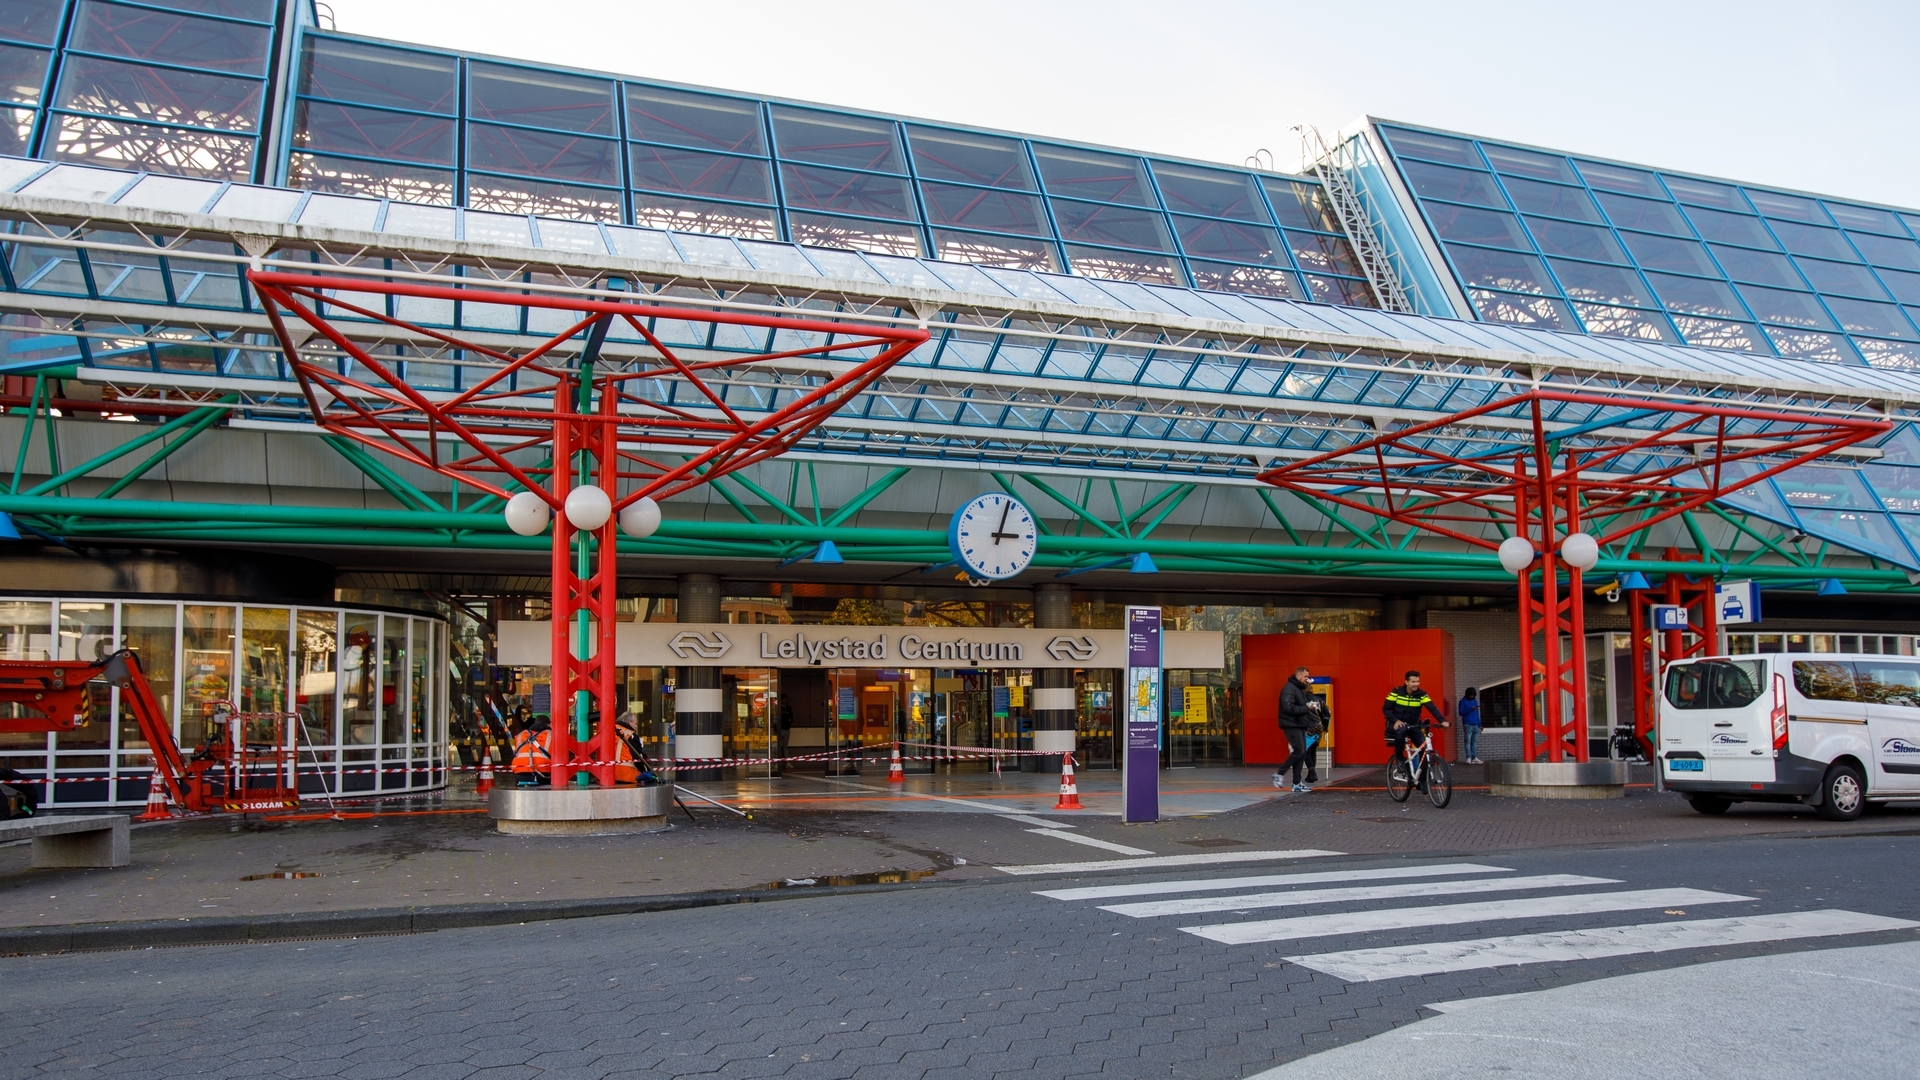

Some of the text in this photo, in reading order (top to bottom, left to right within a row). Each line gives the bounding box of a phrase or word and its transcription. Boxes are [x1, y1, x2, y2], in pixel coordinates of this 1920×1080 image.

[759, 632, 1024, 664] Lelystad Centrum
[250, 801, 283, 809] LOXAM
